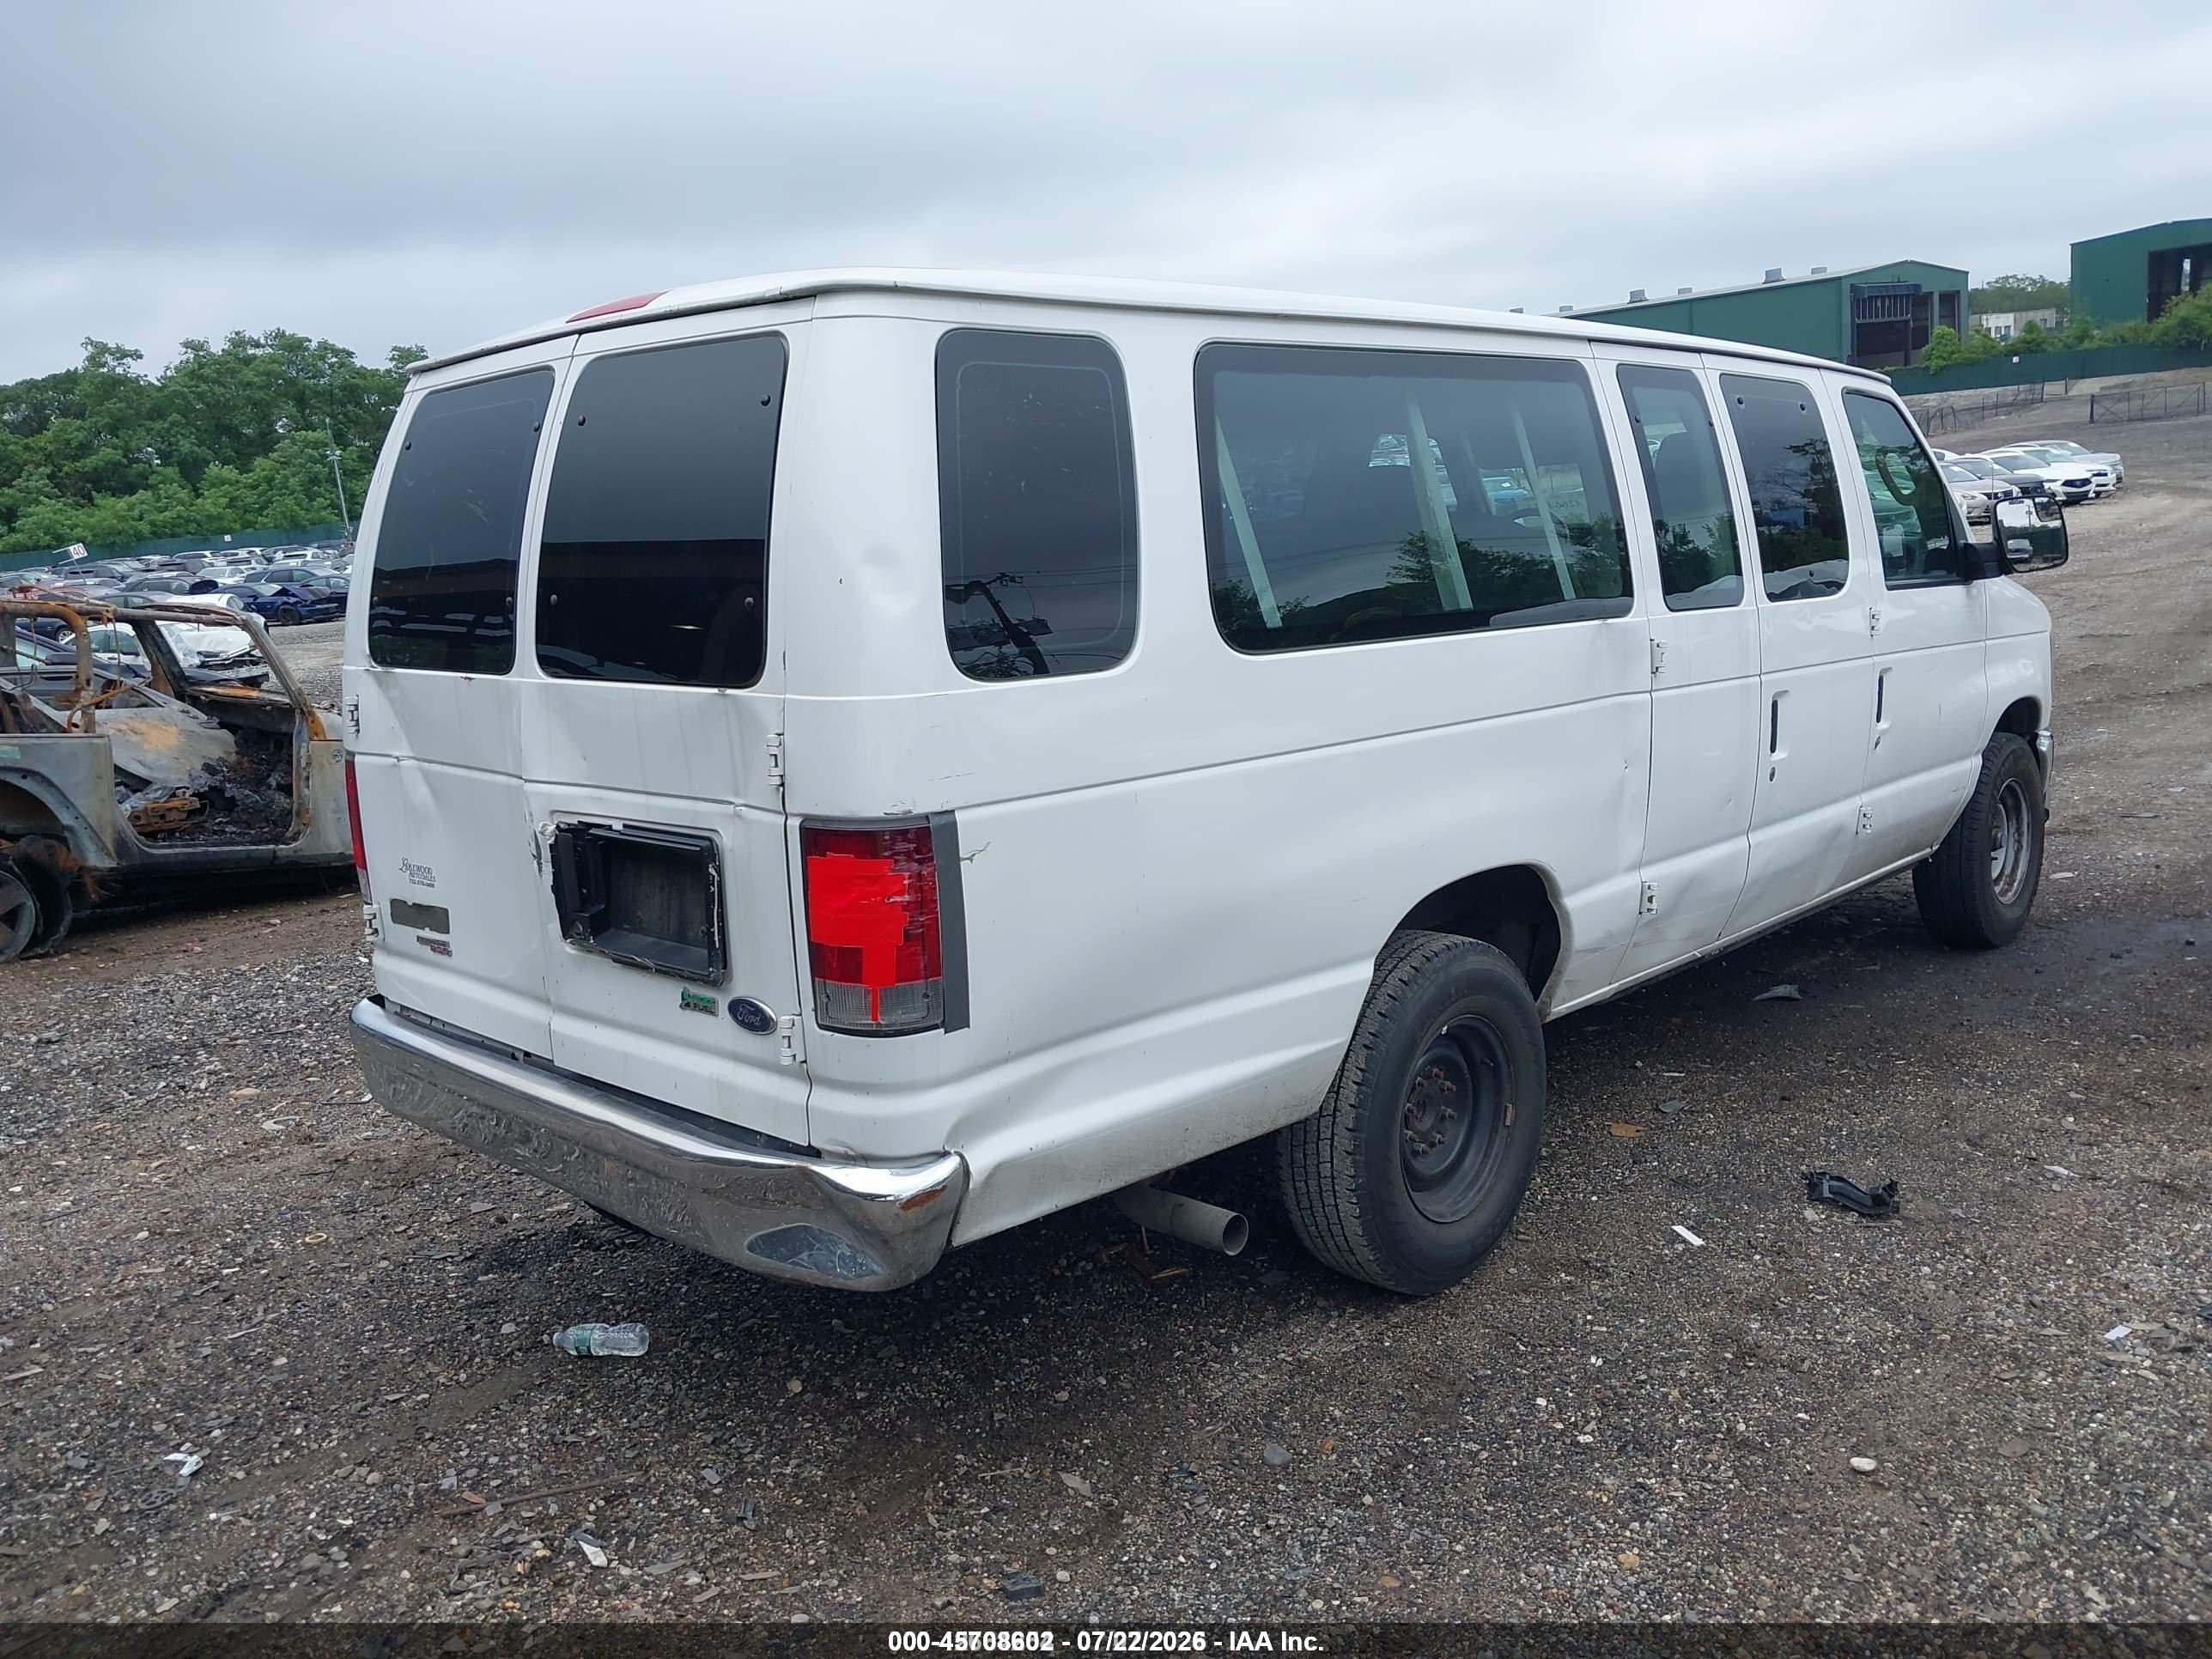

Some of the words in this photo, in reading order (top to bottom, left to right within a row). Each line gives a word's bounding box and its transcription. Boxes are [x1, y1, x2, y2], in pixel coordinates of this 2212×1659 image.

[72, 544, 86, 557] 40
[693, 1002, 715, 1014] FUEL
[737, 1003, 762, 1026] Ford
